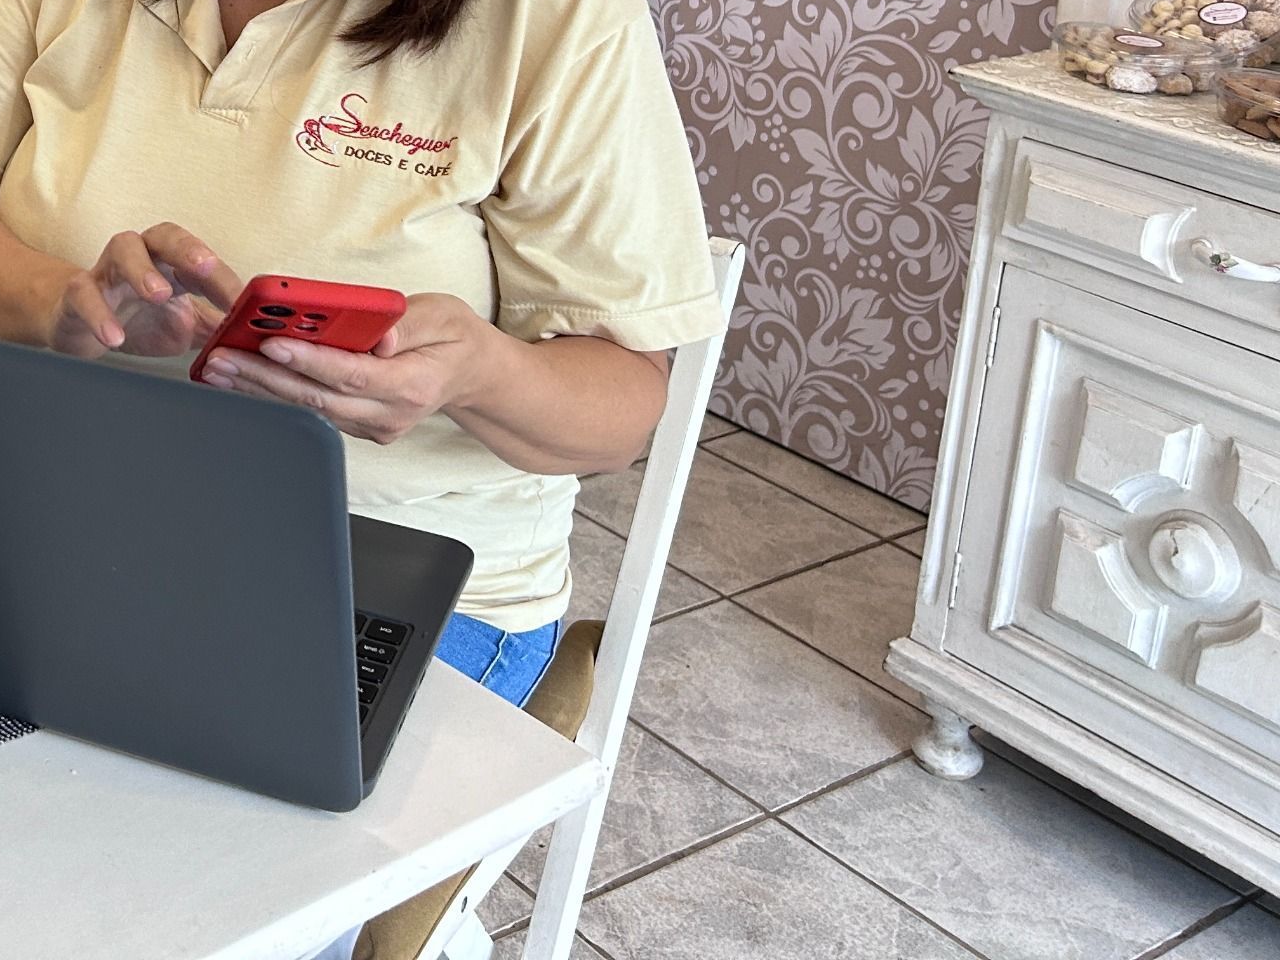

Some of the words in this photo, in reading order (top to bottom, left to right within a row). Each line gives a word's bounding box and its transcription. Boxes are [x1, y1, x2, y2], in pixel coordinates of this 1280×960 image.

[344, 145, 393, 166] DOCES
[398, 158, 410, 171] E
[414, 161, 454, 178] CAFÉ
